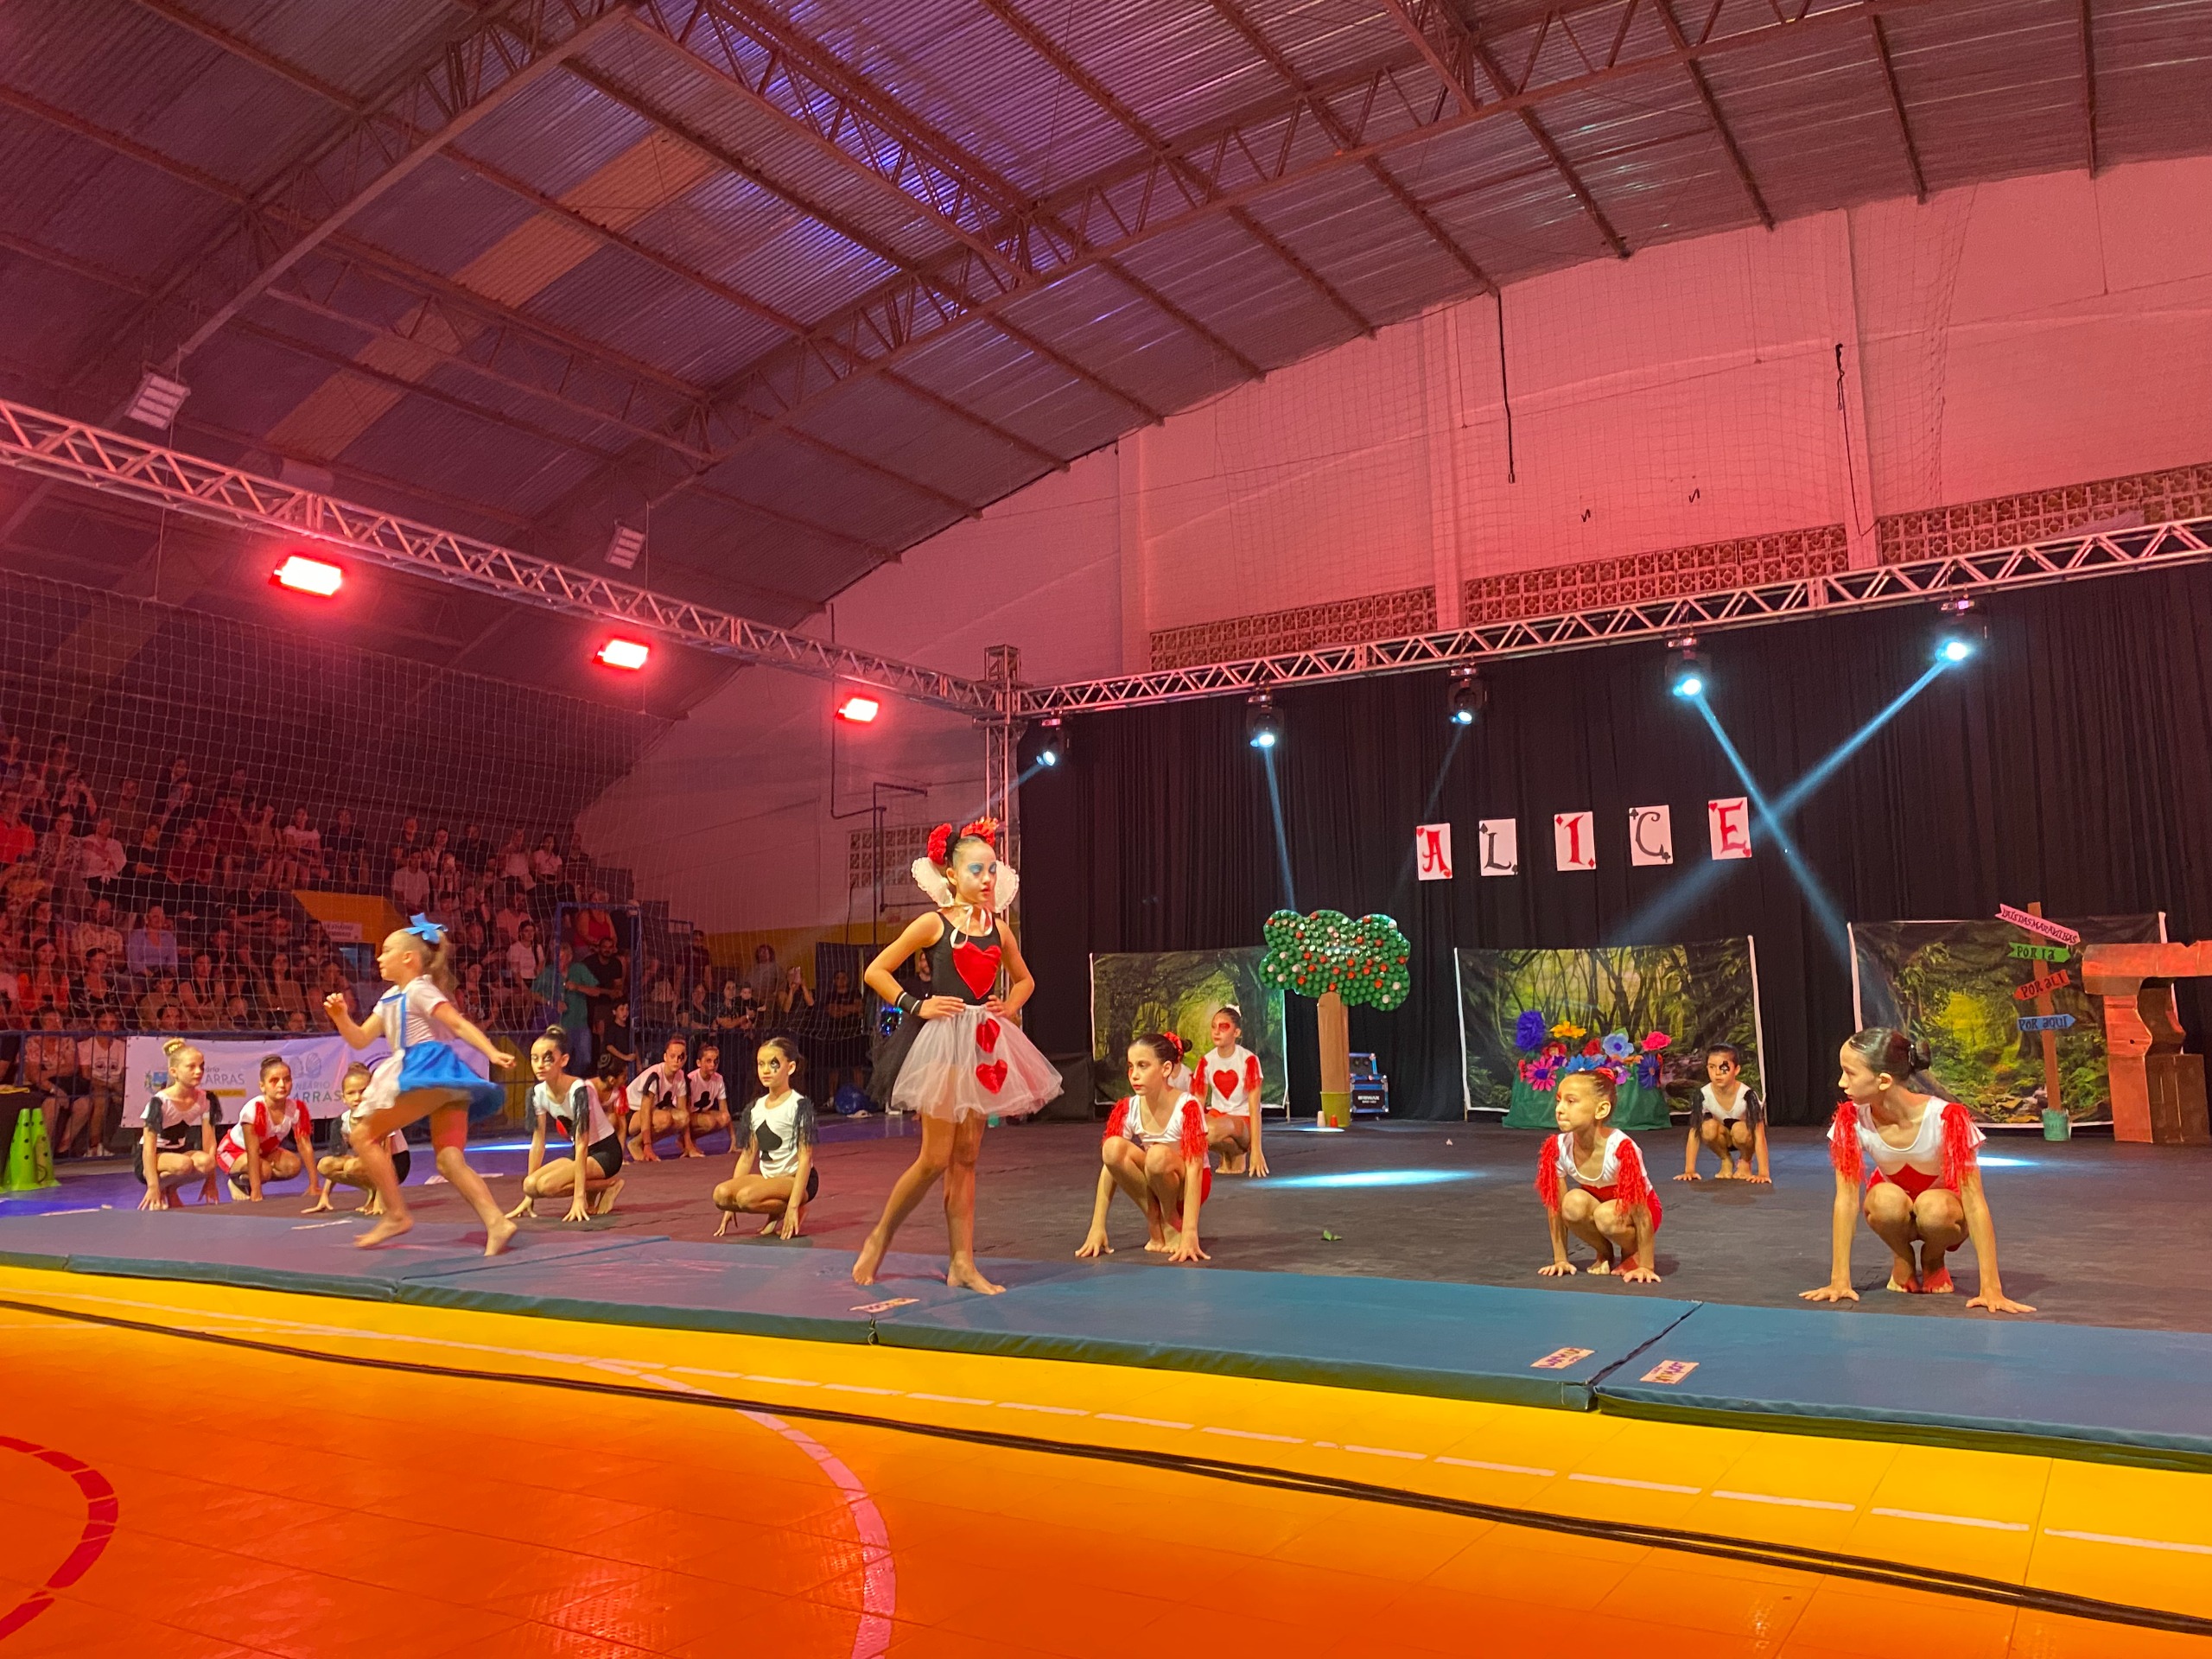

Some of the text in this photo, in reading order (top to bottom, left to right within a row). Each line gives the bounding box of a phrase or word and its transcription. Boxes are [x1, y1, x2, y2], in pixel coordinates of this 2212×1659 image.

[1422, 800, 1746, 873] ALICE
[2017, 945, 2037, 959] POR
[2020, 981, 2044, 997] POR
[2018, 1018, 2038, 1031] POR
[203, 1073, 245, 1086] ARRAS
[293, 1090, 342, 1103] ARRAS
